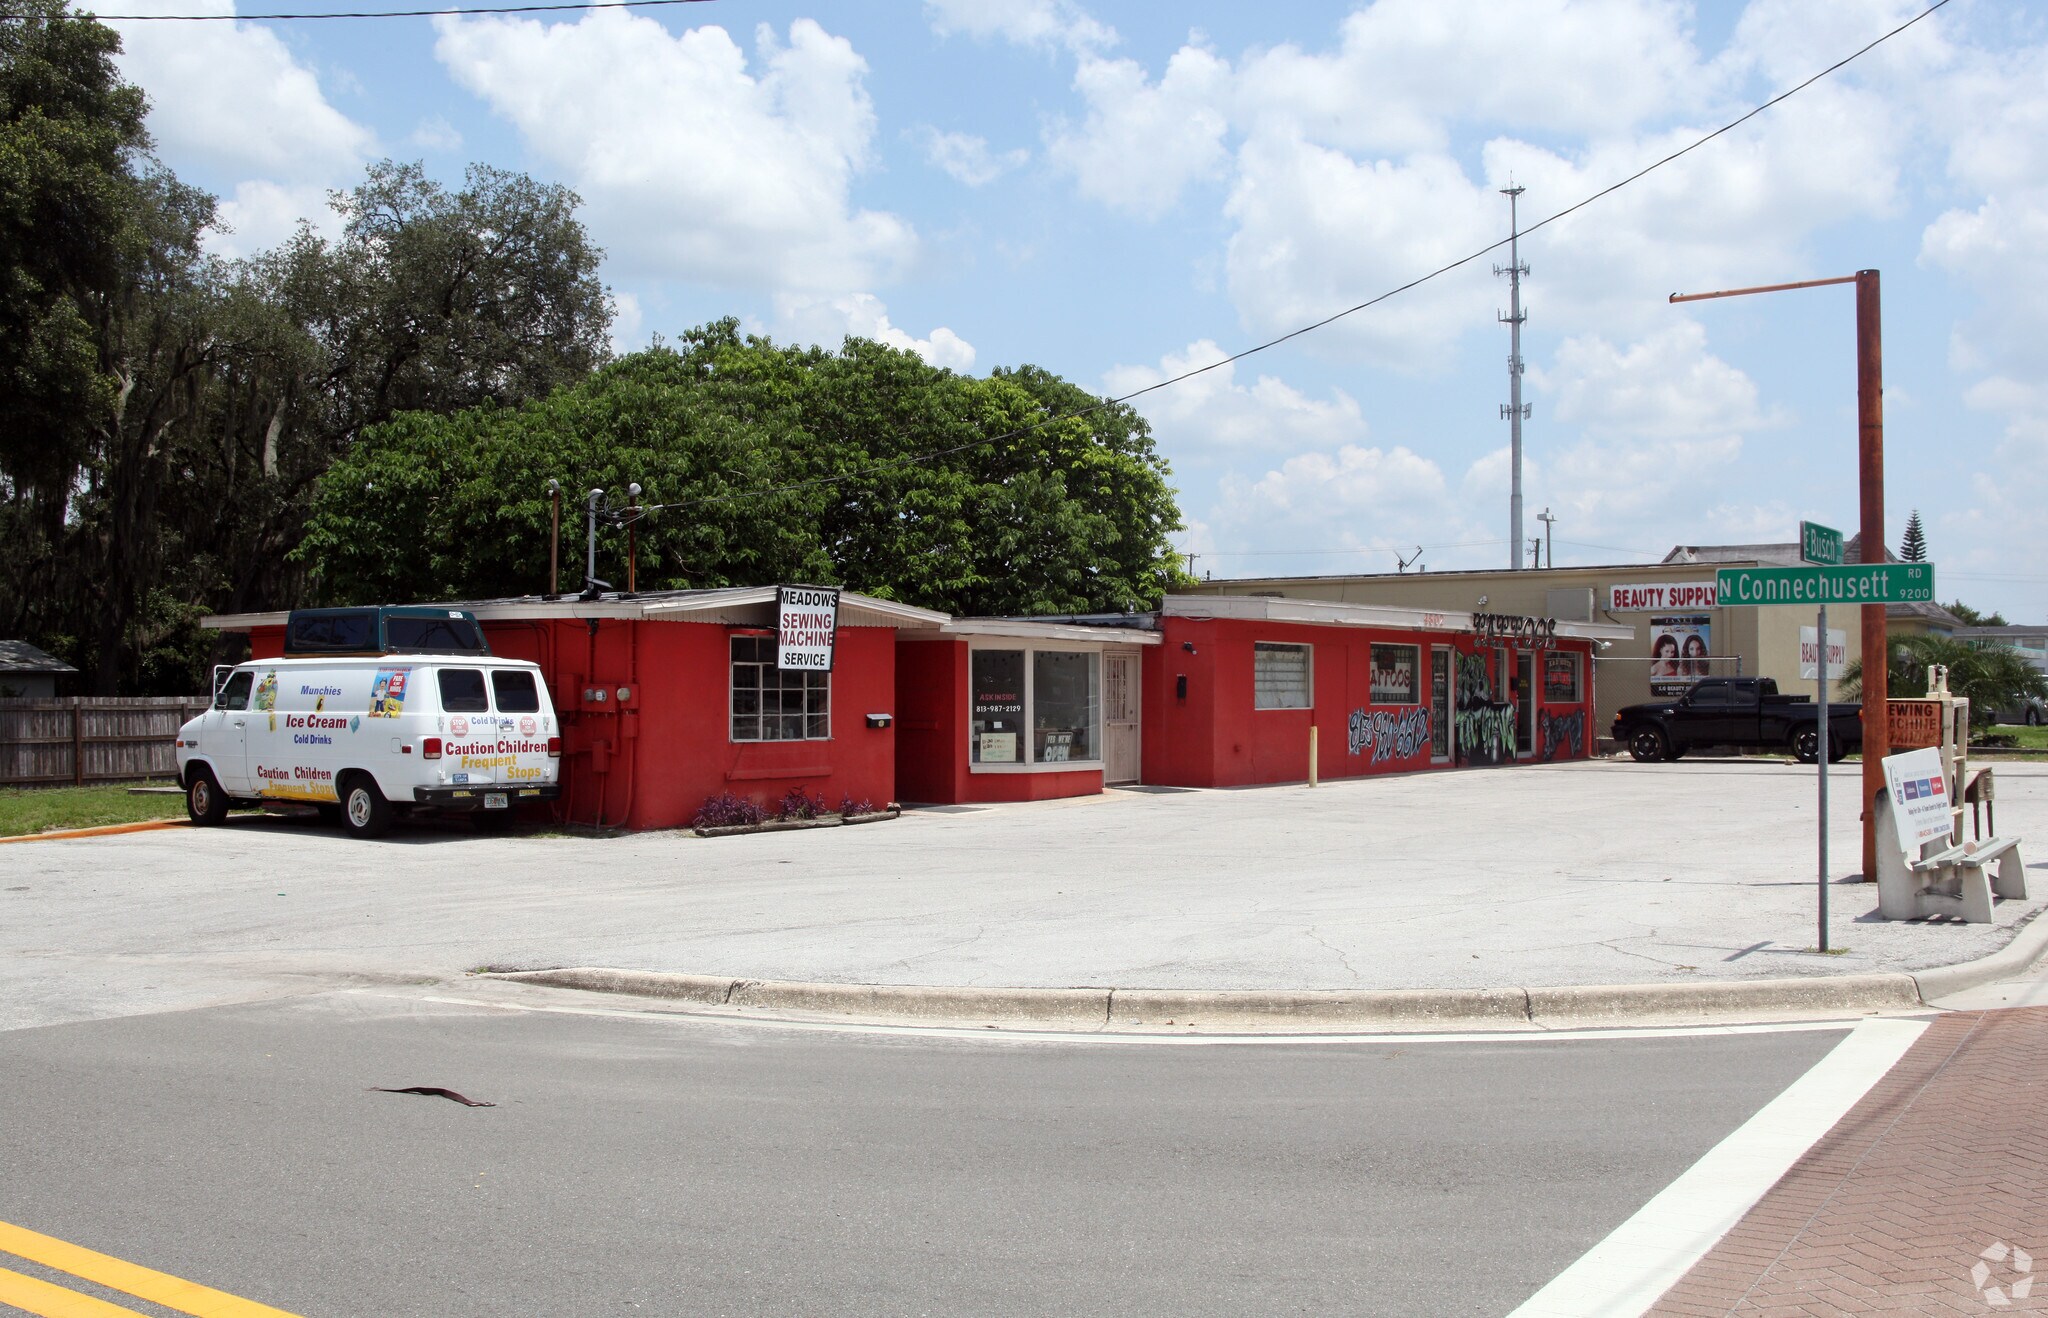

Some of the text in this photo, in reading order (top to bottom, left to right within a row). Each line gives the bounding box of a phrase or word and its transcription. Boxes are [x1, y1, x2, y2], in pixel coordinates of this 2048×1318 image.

[1811, 529, 1835, 561] Busch
[1908, 568, 1922, 579] RD
[1719, 571, 1889, 600] N Connechusett
[781, 591, 837, 607] MEADOWS
[1613, 586, 1717, 607] BEAUTY SUPPLY
[1900, 588, 1929, 599] 9200
[782, 613, 832, 629] SEWING
[779, 630, 833, 647] MACHINE
[784, 652, 826, 666] SERVICE
[1801, 643, 1819, 663] BEAU
[1370, 669, 1411, 688] ATTOOS
[301, 685, 342, 696] Munchies
[1888, 704, 1933, 717] EWING
[286, 714, 347, 728] Ice Cream
[471, 717, 488, 725] Cold
[294, 734, 332, 744] Cold Drinks
[445, 740, 547, 755] Caution Children
[461, 754, 517, 770] Frequent
[257, 765, 332, 780] Caution Children
[507, 766, 541, 780] Stops
